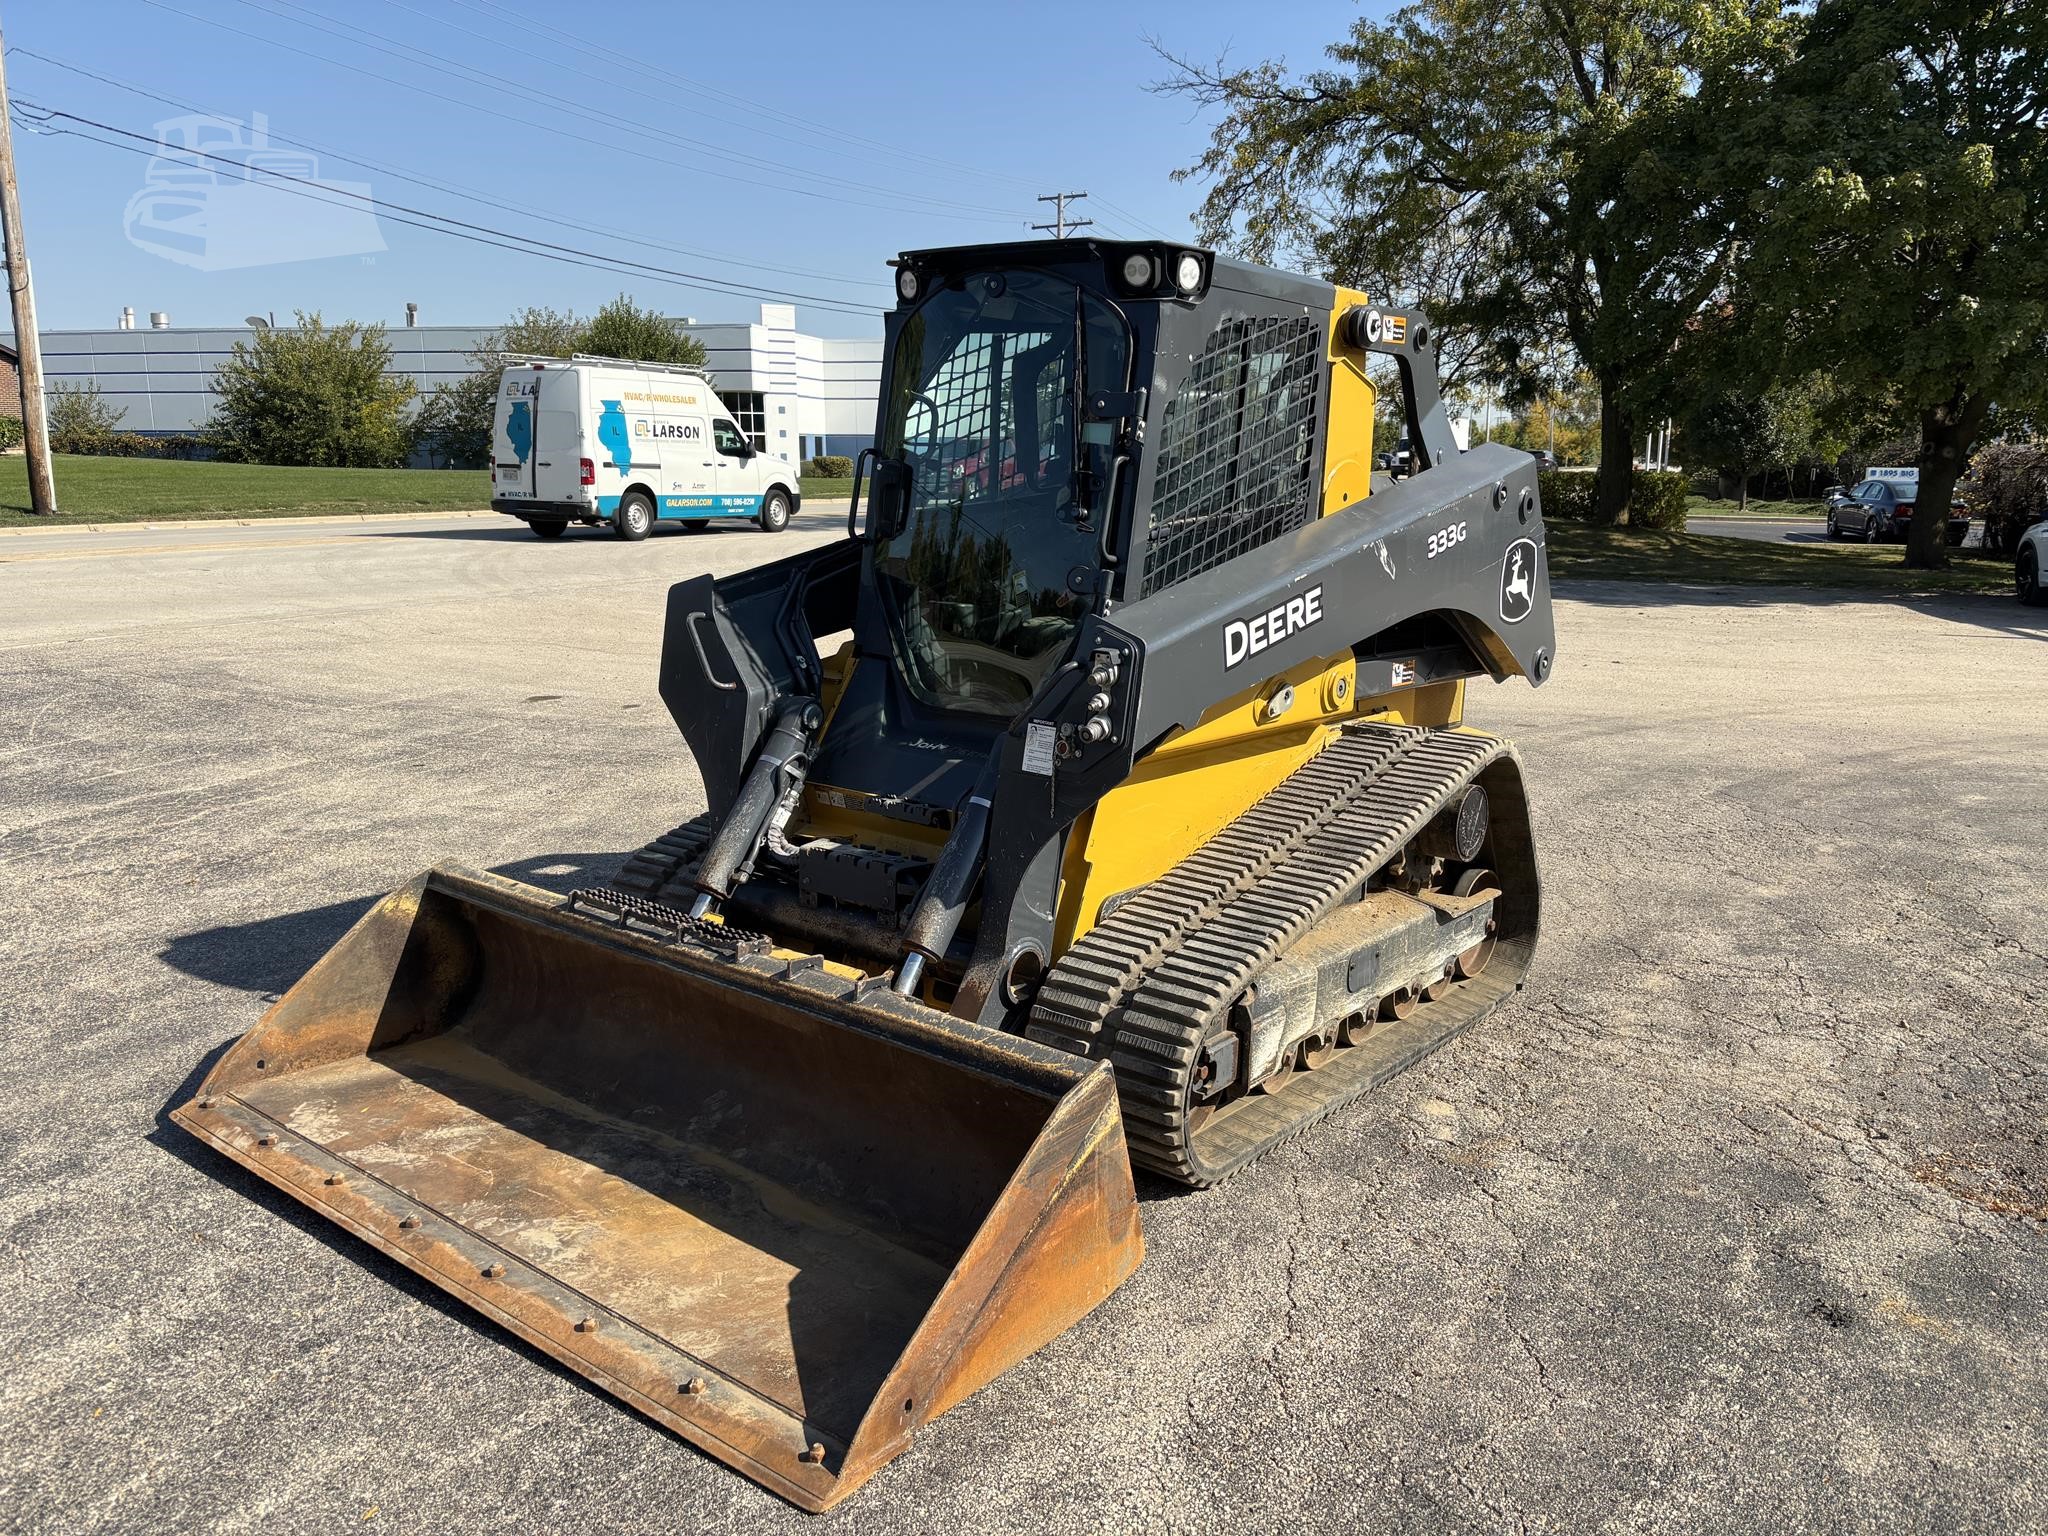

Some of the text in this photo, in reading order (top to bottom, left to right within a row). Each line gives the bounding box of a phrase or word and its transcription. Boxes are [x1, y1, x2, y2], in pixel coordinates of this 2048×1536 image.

[652, 394, 697, 405] WHOLESALER
[612, 426, 620, 436] IL
[653, 424, 700, 439] LARSON
[1427, 522, 1467, 560] 333G
[1224, 587, 1322, 668] DEERE
